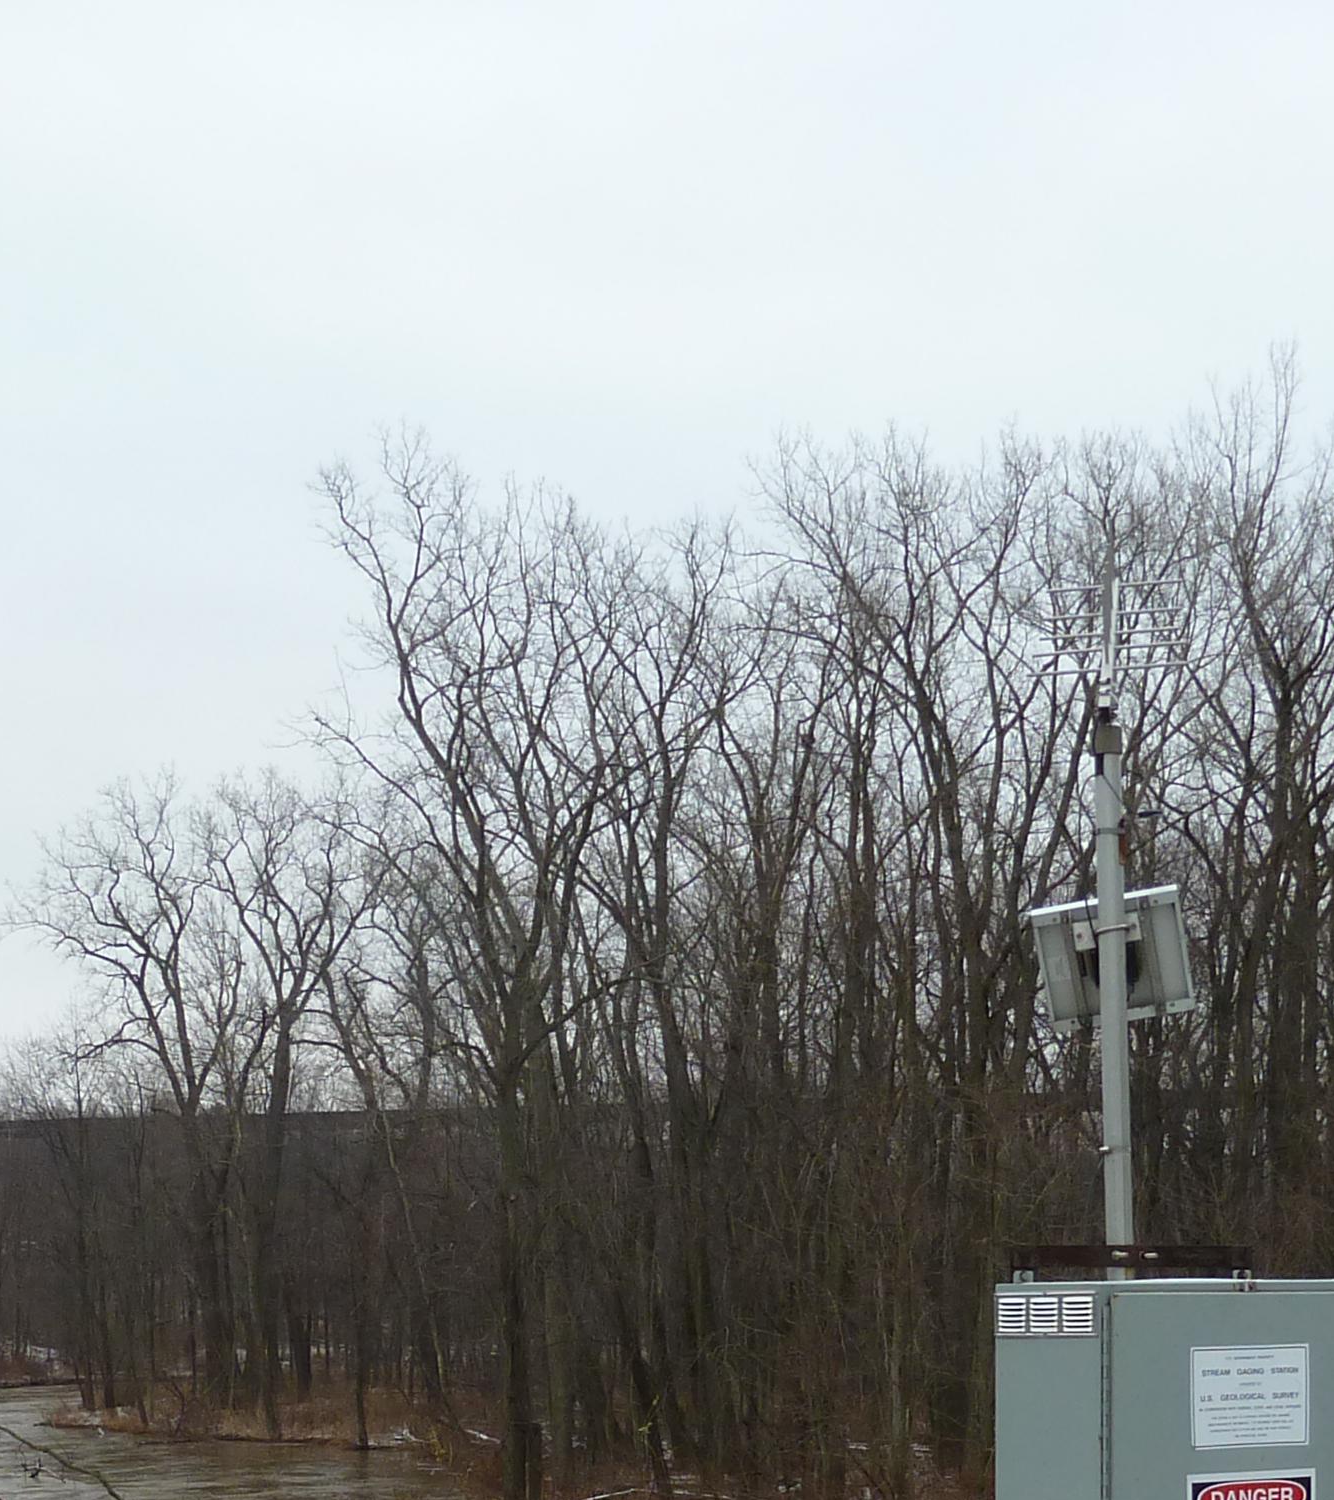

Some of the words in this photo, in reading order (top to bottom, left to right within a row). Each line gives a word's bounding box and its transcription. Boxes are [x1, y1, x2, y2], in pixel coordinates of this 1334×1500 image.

[1201, 1369, 1231, 1377] STREAM
[1270, 1366, 1299, 1374] STATION
[1220, 1392, 1266, 1401] GEOLOGICAL
[1272, 1391, 1299, 1399] SURVEY
